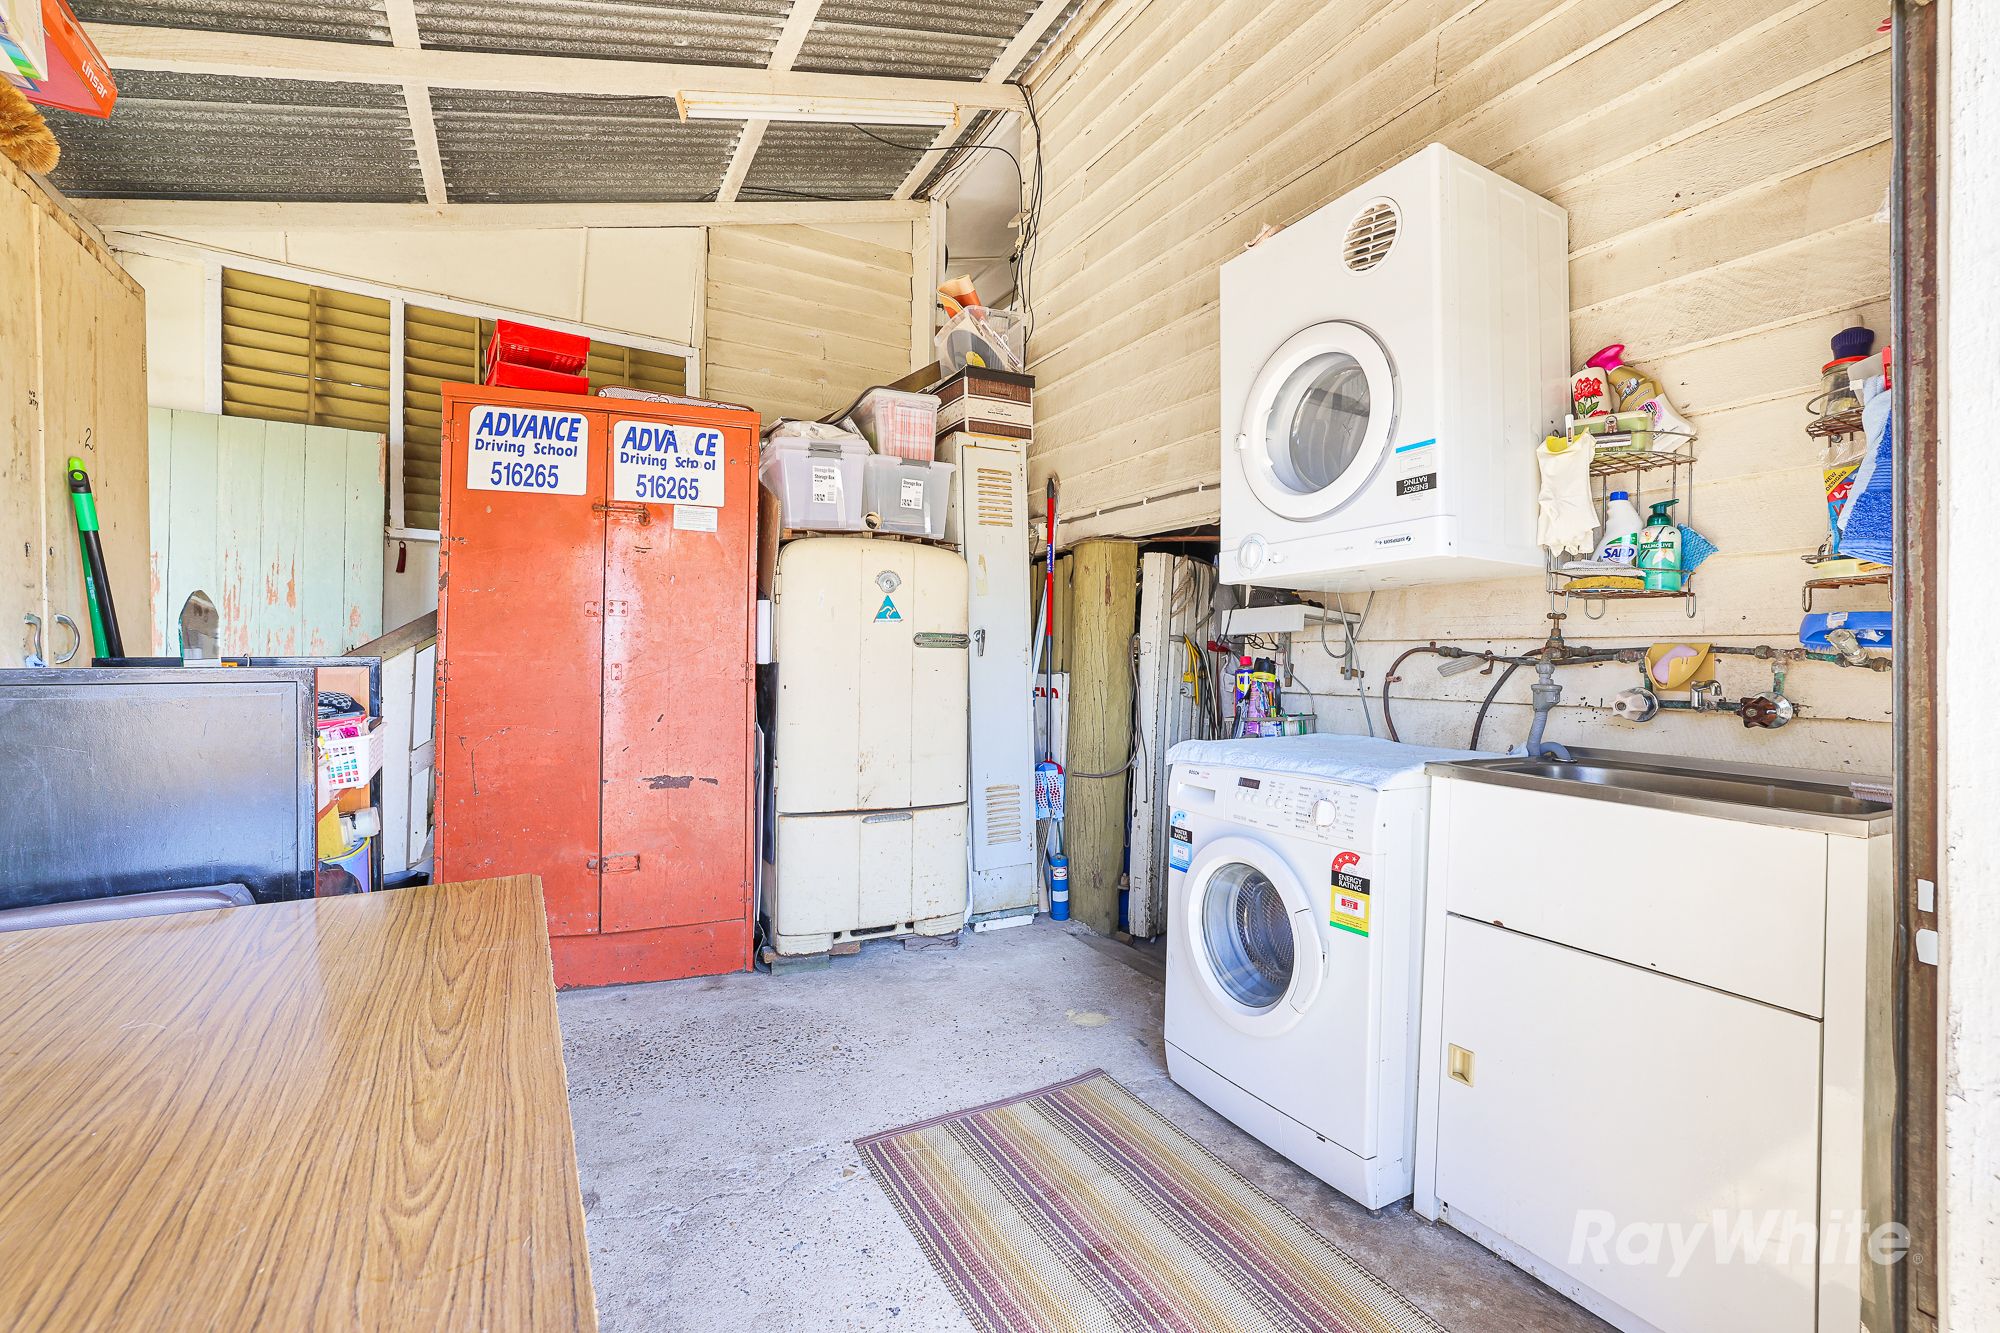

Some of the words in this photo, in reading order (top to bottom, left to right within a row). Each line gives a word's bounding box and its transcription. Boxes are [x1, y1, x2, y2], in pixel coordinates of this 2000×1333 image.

[476, 411, 582, 443] ADVANCE
[84, 427, 94, 451] 2
[474, 438, 526, 458] Driving
[533, 442, 578, 458] School
[621, 425, 719, 457] ADVACE
[619, 451, 668, 471] Driving
[490, 461, 559, 490] 516265
[1403, 475, 1428, 487] RATING
[1825, 471, 1837, 484] NEW
[635, 474, 700, 501] 516265
[1403, 483, 1429, 494] ENERGY
[1338, 873, 1363, 885] ENERGY
[1338, 880, 1362, 892] RATING
